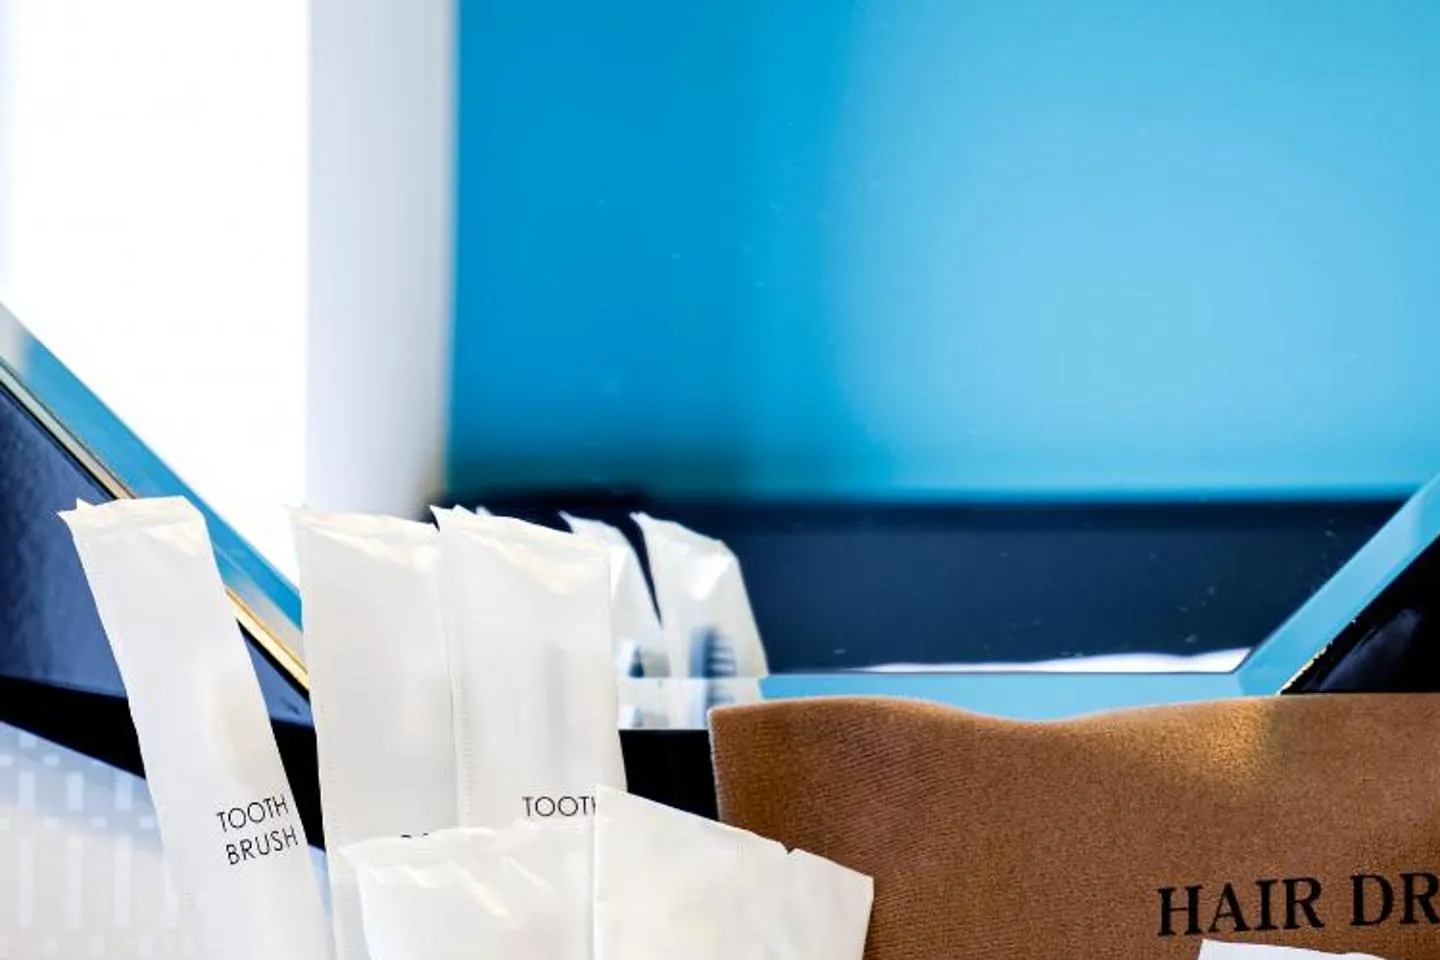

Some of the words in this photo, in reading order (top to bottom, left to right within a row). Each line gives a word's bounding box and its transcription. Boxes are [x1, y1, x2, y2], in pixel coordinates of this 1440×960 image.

[216, 794, 289, 832] TOOTH
[225, 825, 299, 866] BRUSH
[1157, 877, 1324, 936] HAIR
